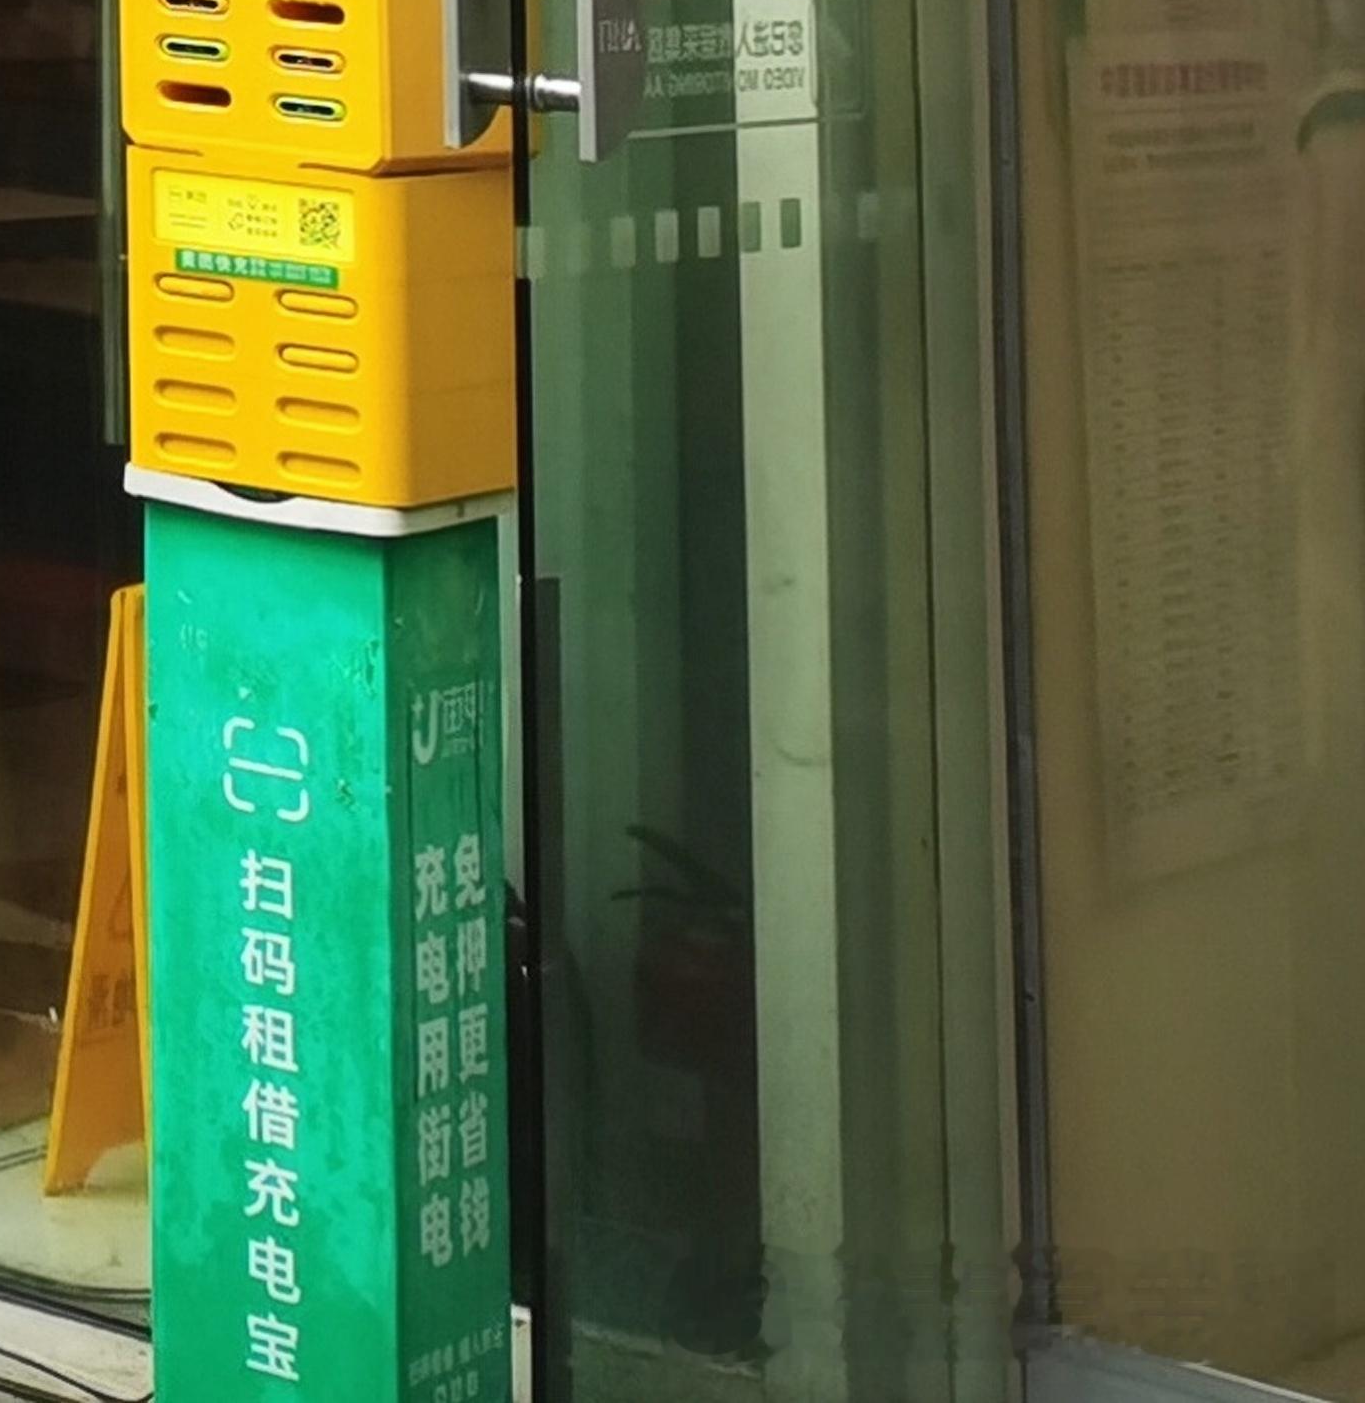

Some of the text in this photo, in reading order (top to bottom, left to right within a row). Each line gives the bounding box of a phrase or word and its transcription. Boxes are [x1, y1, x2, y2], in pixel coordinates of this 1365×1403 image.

[238, 849, 302, 1385] 扫码租借充电宝
[413, 843, 454, 1270] 充电用街电
[452, 832, 491, 1259] 免押更省钱
